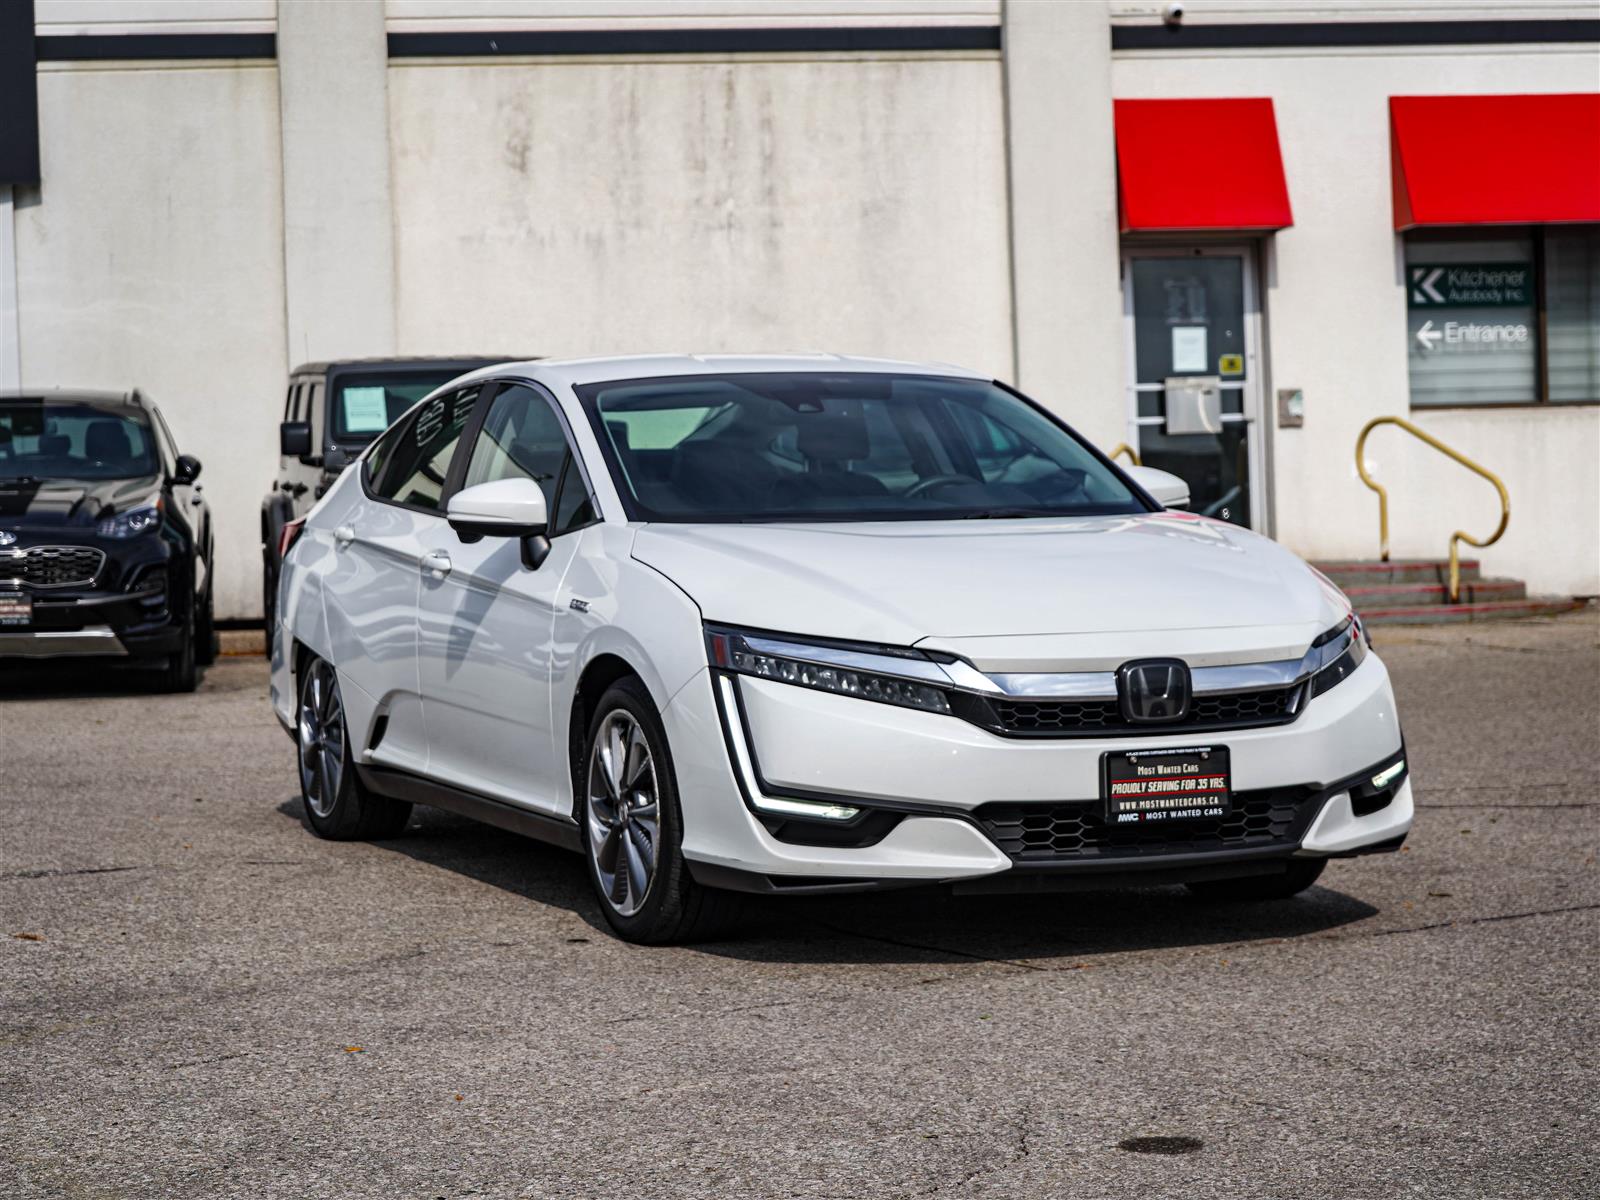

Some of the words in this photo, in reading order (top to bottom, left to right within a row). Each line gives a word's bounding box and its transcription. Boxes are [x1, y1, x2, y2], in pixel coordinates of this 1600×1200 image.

[1447, 269, 1527, 287] Kitchener
[1449, 287, 1502, 302] Autobody
[1444, 321, 1528, 343] Entrance
[1111, 781, 1147, 795] PROUDLY
[1147, 780, 1180, 793] SERVING
[1180, 779, 1196, 791] FOR
[1197, 778, 1208, 790] 35
[1120, 796, 1219, 810] WWW.MOSTWANTEDCARS.CA
[1145, 811, 1167, 820] MOST
[1170, 808, 1201, 819] WANTED
[1203, 807, 1223, 817] CARS
